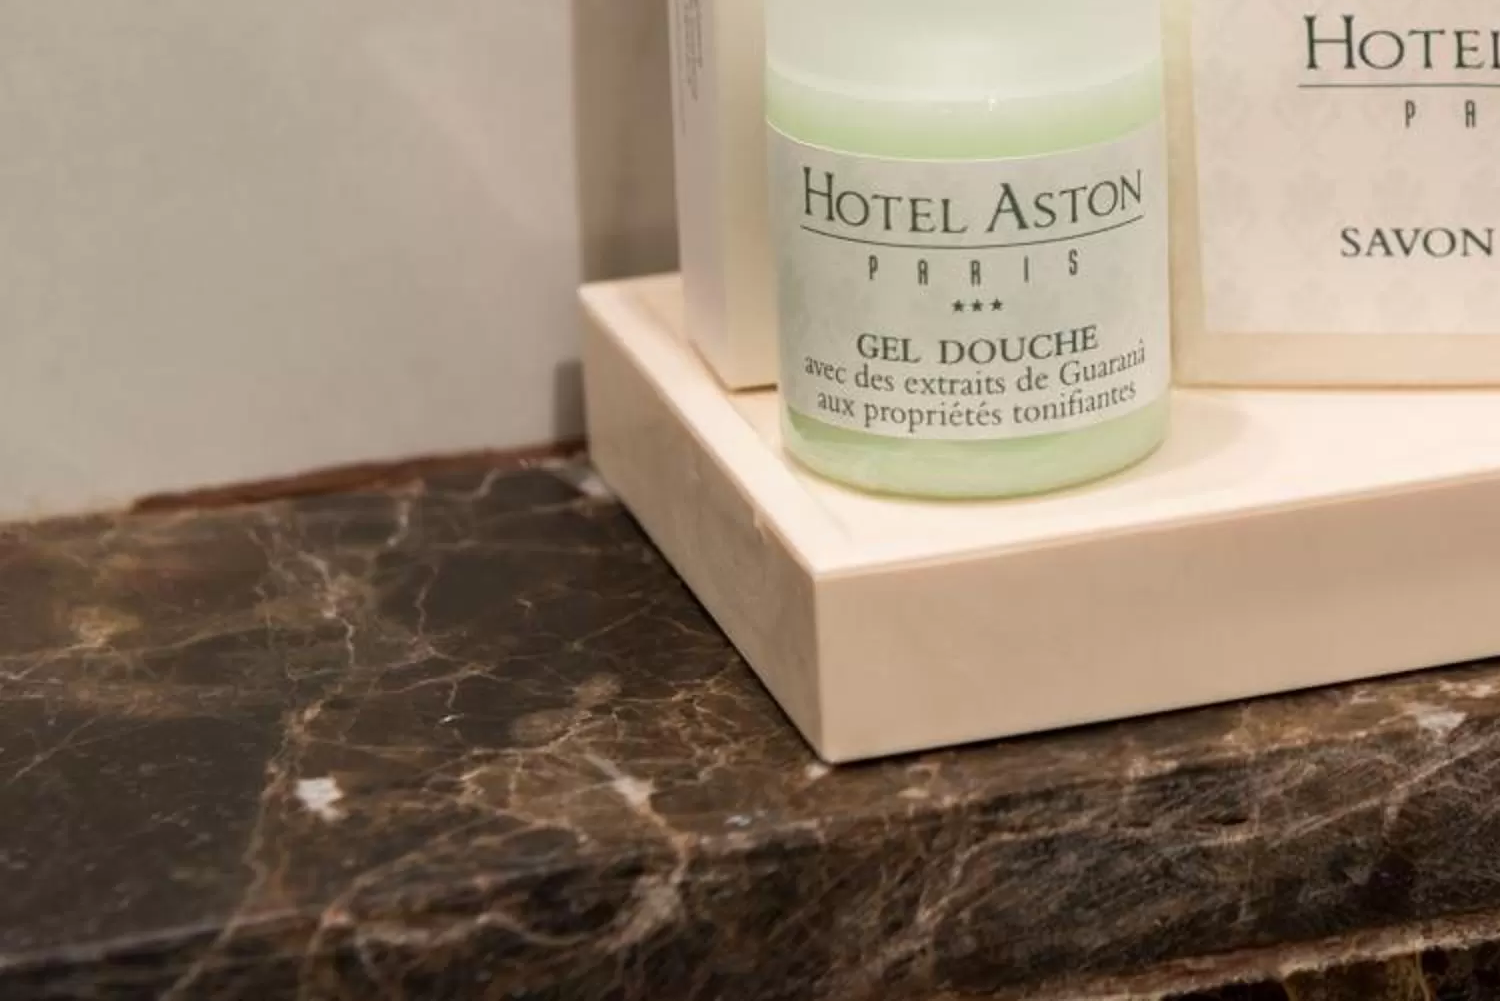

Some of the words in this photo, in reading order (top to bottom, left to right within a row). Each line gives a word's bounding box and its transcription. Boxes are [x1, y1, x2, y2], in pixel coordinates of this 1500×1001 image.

[803, 166, 967, 234] HOTEL
[985, 169, 1142, 233] ASTON
[1340, 226, 1494, 259] SAVON
[868, 249, 1079, 286] PARIS
[857, 333, 921, 364] GEL
[939, 324, 1098, 366] DOUCHE
[804, 355, 847, 385] avec
[855, 363, 895, 392] des
[904, 370, 1005, 396] extraits
[1017, 369, 1048, 393] de
[818, 392, 855, 418] aux
[864, 401, 1003, 433] propriétés
[1012, 381, 1136, 425] tonifiantes
